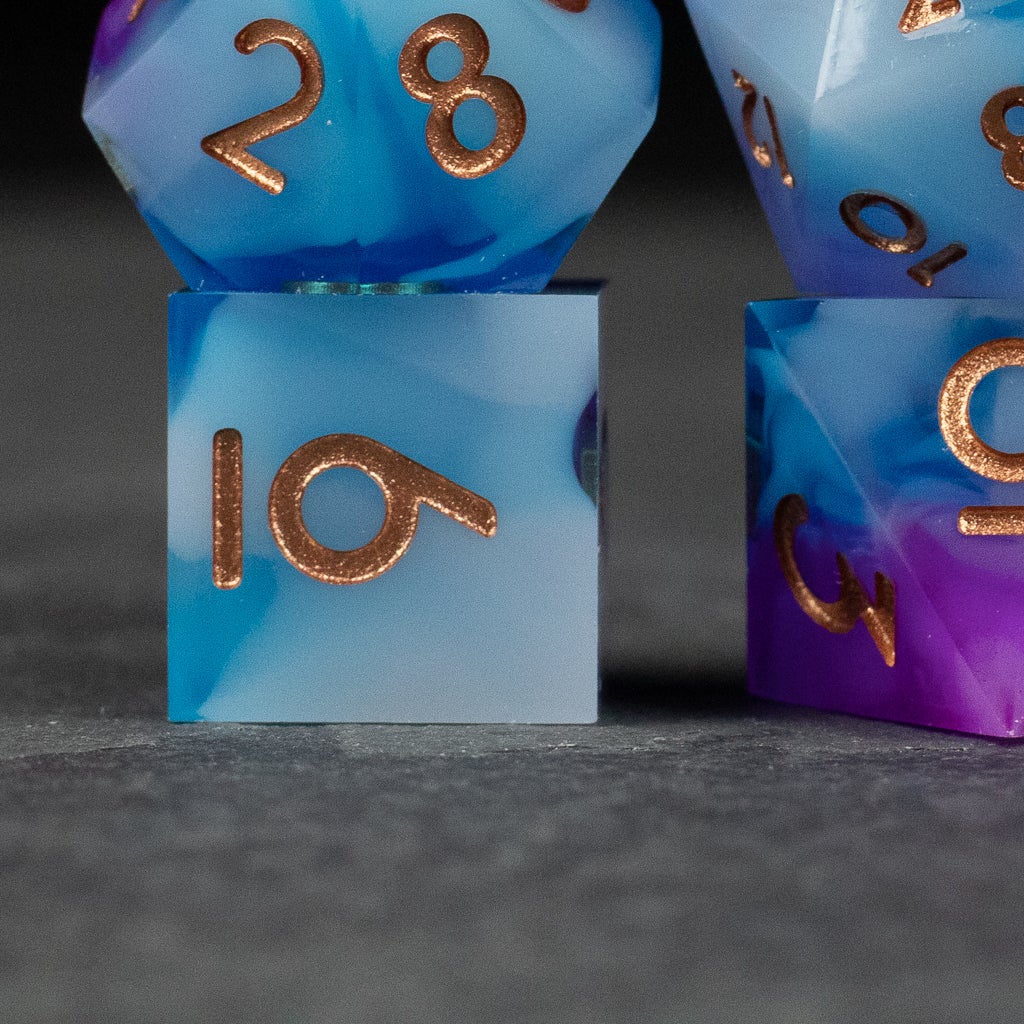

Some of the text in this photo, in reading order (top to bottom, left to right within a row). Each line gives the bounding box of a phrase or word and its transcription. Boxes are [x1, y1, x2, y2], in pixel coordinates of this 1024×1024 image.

[202, 18, 322, 194] 2
[398, 13, 527, 179] 8
[838, 190, 968, 288] 10
[773, 492, 897, 668] 3
